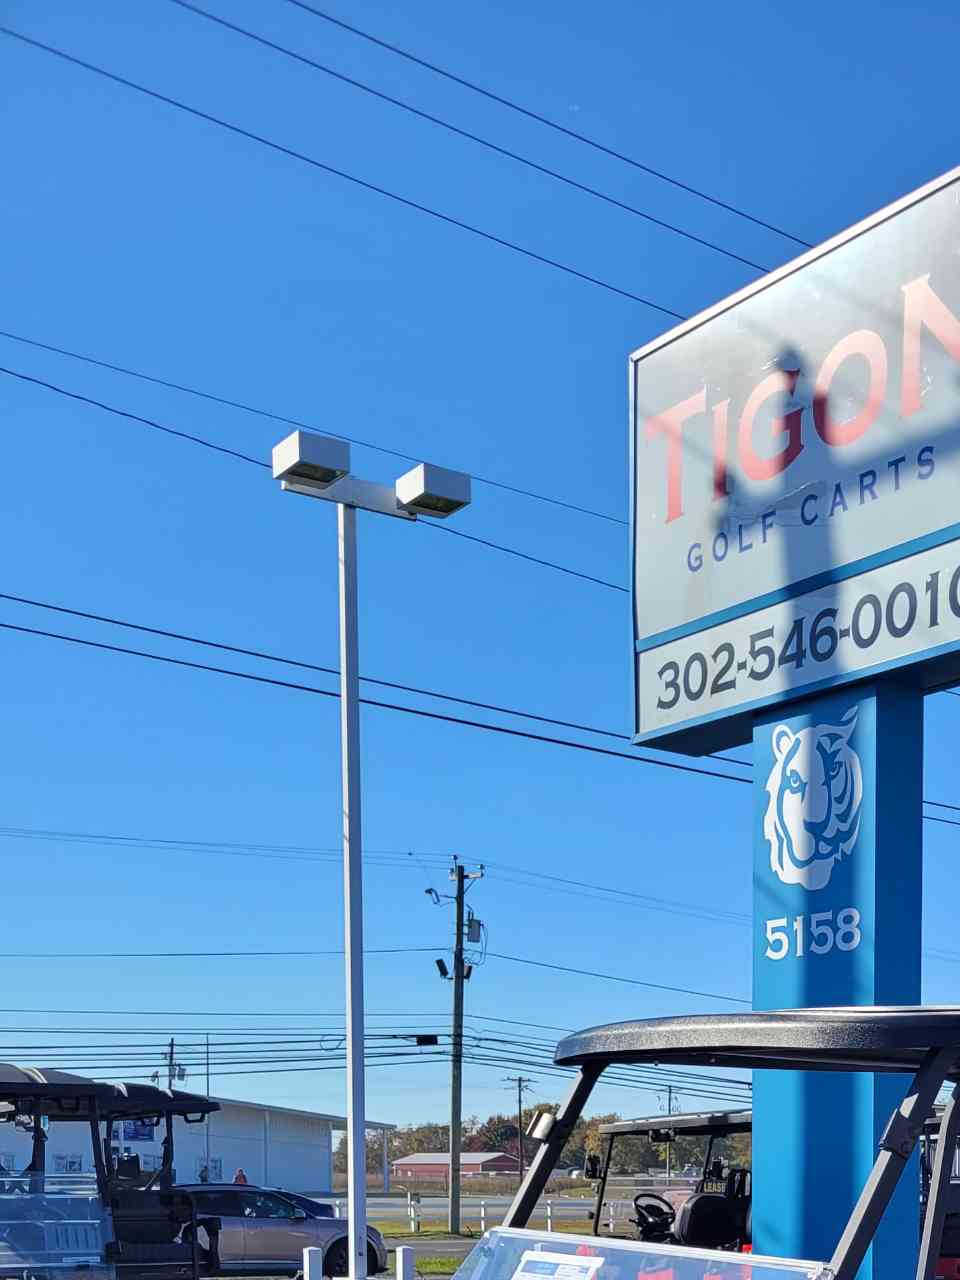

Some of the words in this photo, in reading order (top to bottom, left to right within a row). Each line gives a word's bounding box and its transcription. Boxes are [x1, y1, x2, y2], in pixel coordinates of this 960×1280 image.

[686, 508, 777, 574] GOLF
[799, 445, 938, 526] CARTS
[764, 907, 862, 961] 5158
